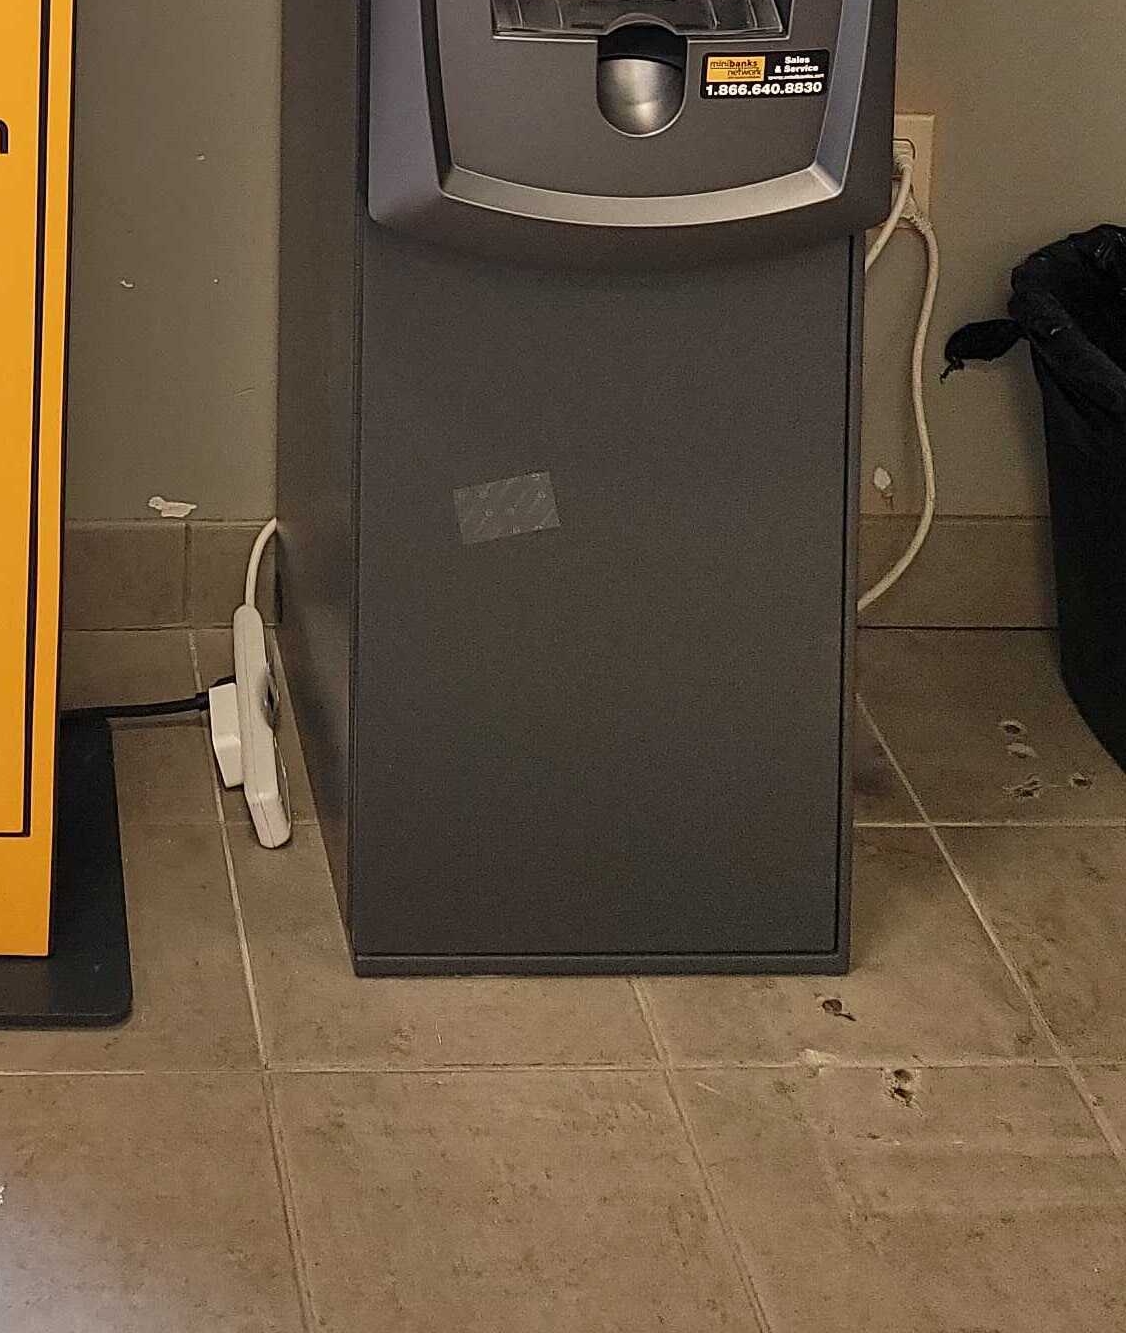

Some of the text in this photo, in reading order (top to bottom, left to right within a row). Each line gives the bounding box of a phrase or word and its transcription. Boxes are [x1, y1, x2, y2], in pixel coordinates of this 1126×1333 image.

[710, 59, 759, 69] minibanks
[784, 55, 811, 65] Sales
[727, 68, 761, 77] network
[774, 64, 819, 74] & Service
[705, 81, 823, 96] 1.866.640.8830
